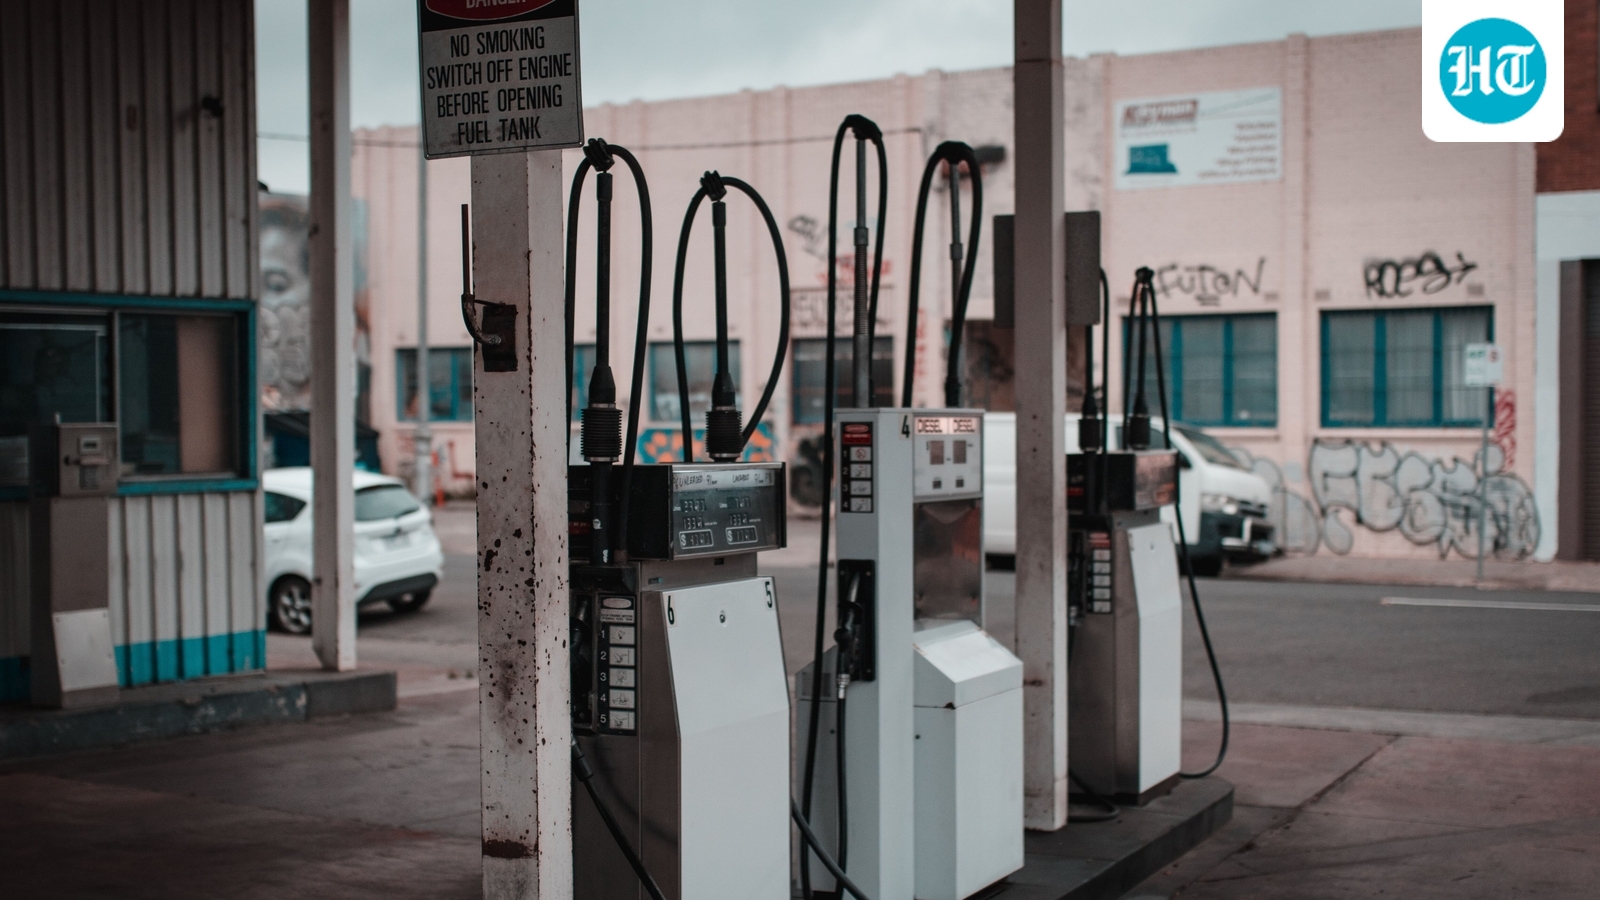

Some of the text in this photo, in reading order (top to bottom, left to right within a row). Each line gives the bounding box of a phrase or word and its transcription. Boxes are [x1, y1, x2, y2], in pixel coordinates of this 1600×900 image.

[450, 26, 545, 58] NO SMOKING
[427, 53, 572, 89] SWITCH OFF ENGINE
[437, 84, 562, 118] BEFORE OPENING
[457, 116, 541, 145] FUEL TANK
[901, 415, 910, 438] 4
[765, 581, 773, 608] 5
[667, 595, 675, 625] 6
[601, 630, 606, 638] 1
[600, 652, 607, 660] 2
[600, 673, 607, 681] 3
[600, 693, 607, 702] 4
[600, 715, 607, 724] 5
